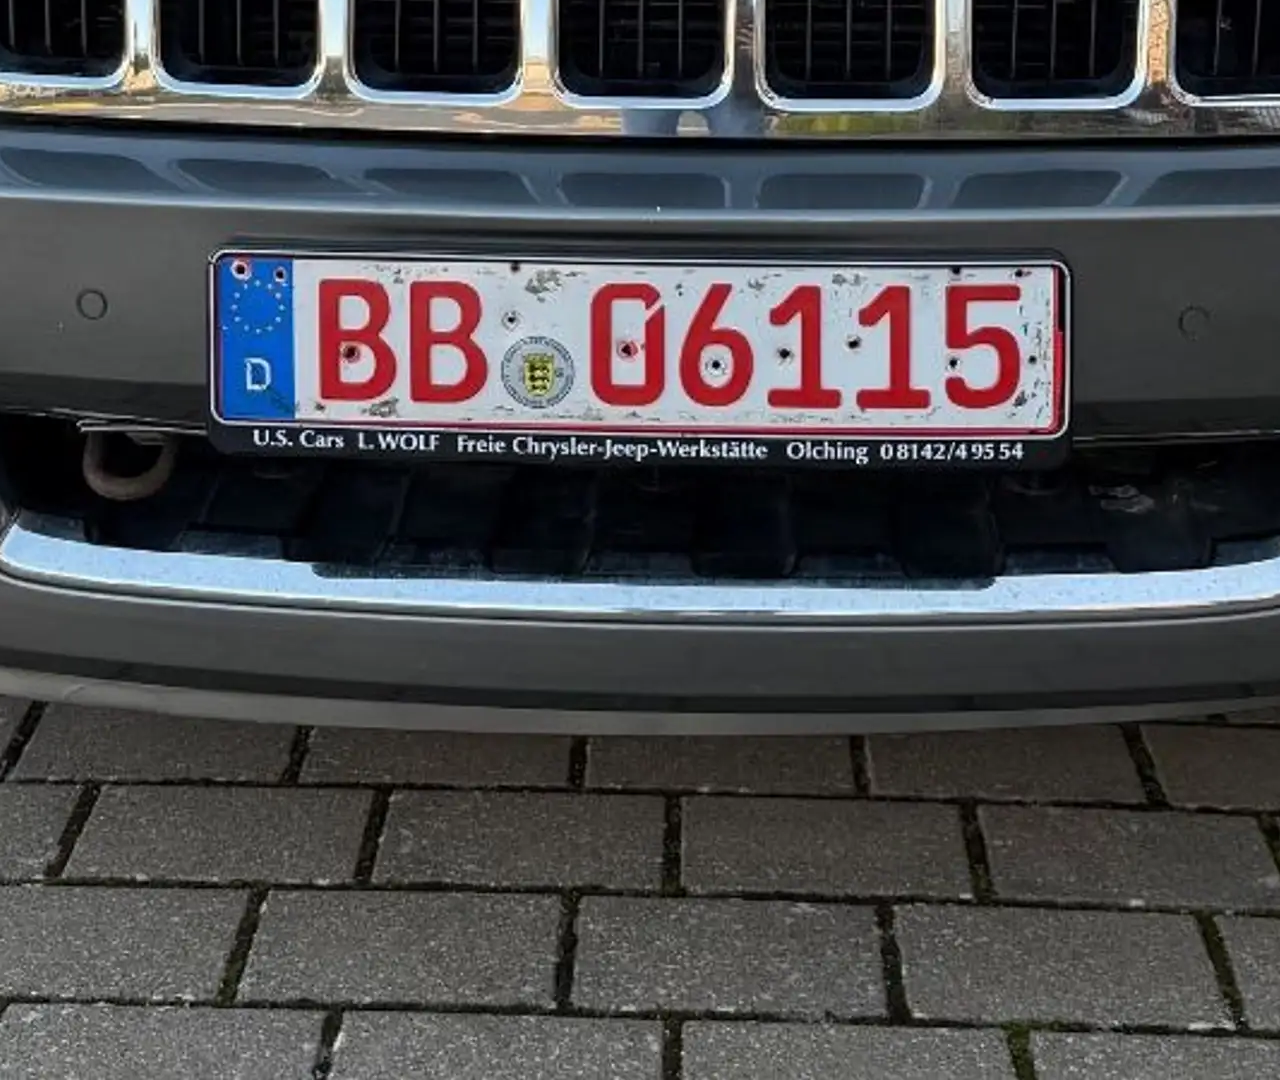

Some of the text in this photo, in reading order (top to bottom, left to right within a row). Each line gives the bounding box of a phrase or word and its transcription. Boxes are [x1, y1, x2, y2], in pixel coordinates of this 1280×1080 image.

[319, 278, 488, 402] BB
[590, 283, 1021, 409] 06115
[245, 357, 271, 391] D
[252, 429, 293, 447] U.S.
[299, 429, 345, 449] Cars
[456, 435, 507, 454] Freie
[512, 436, 768, 462] Chrysler-Jeep-Werkstätte
[786, 440, 869, 465] Olching
